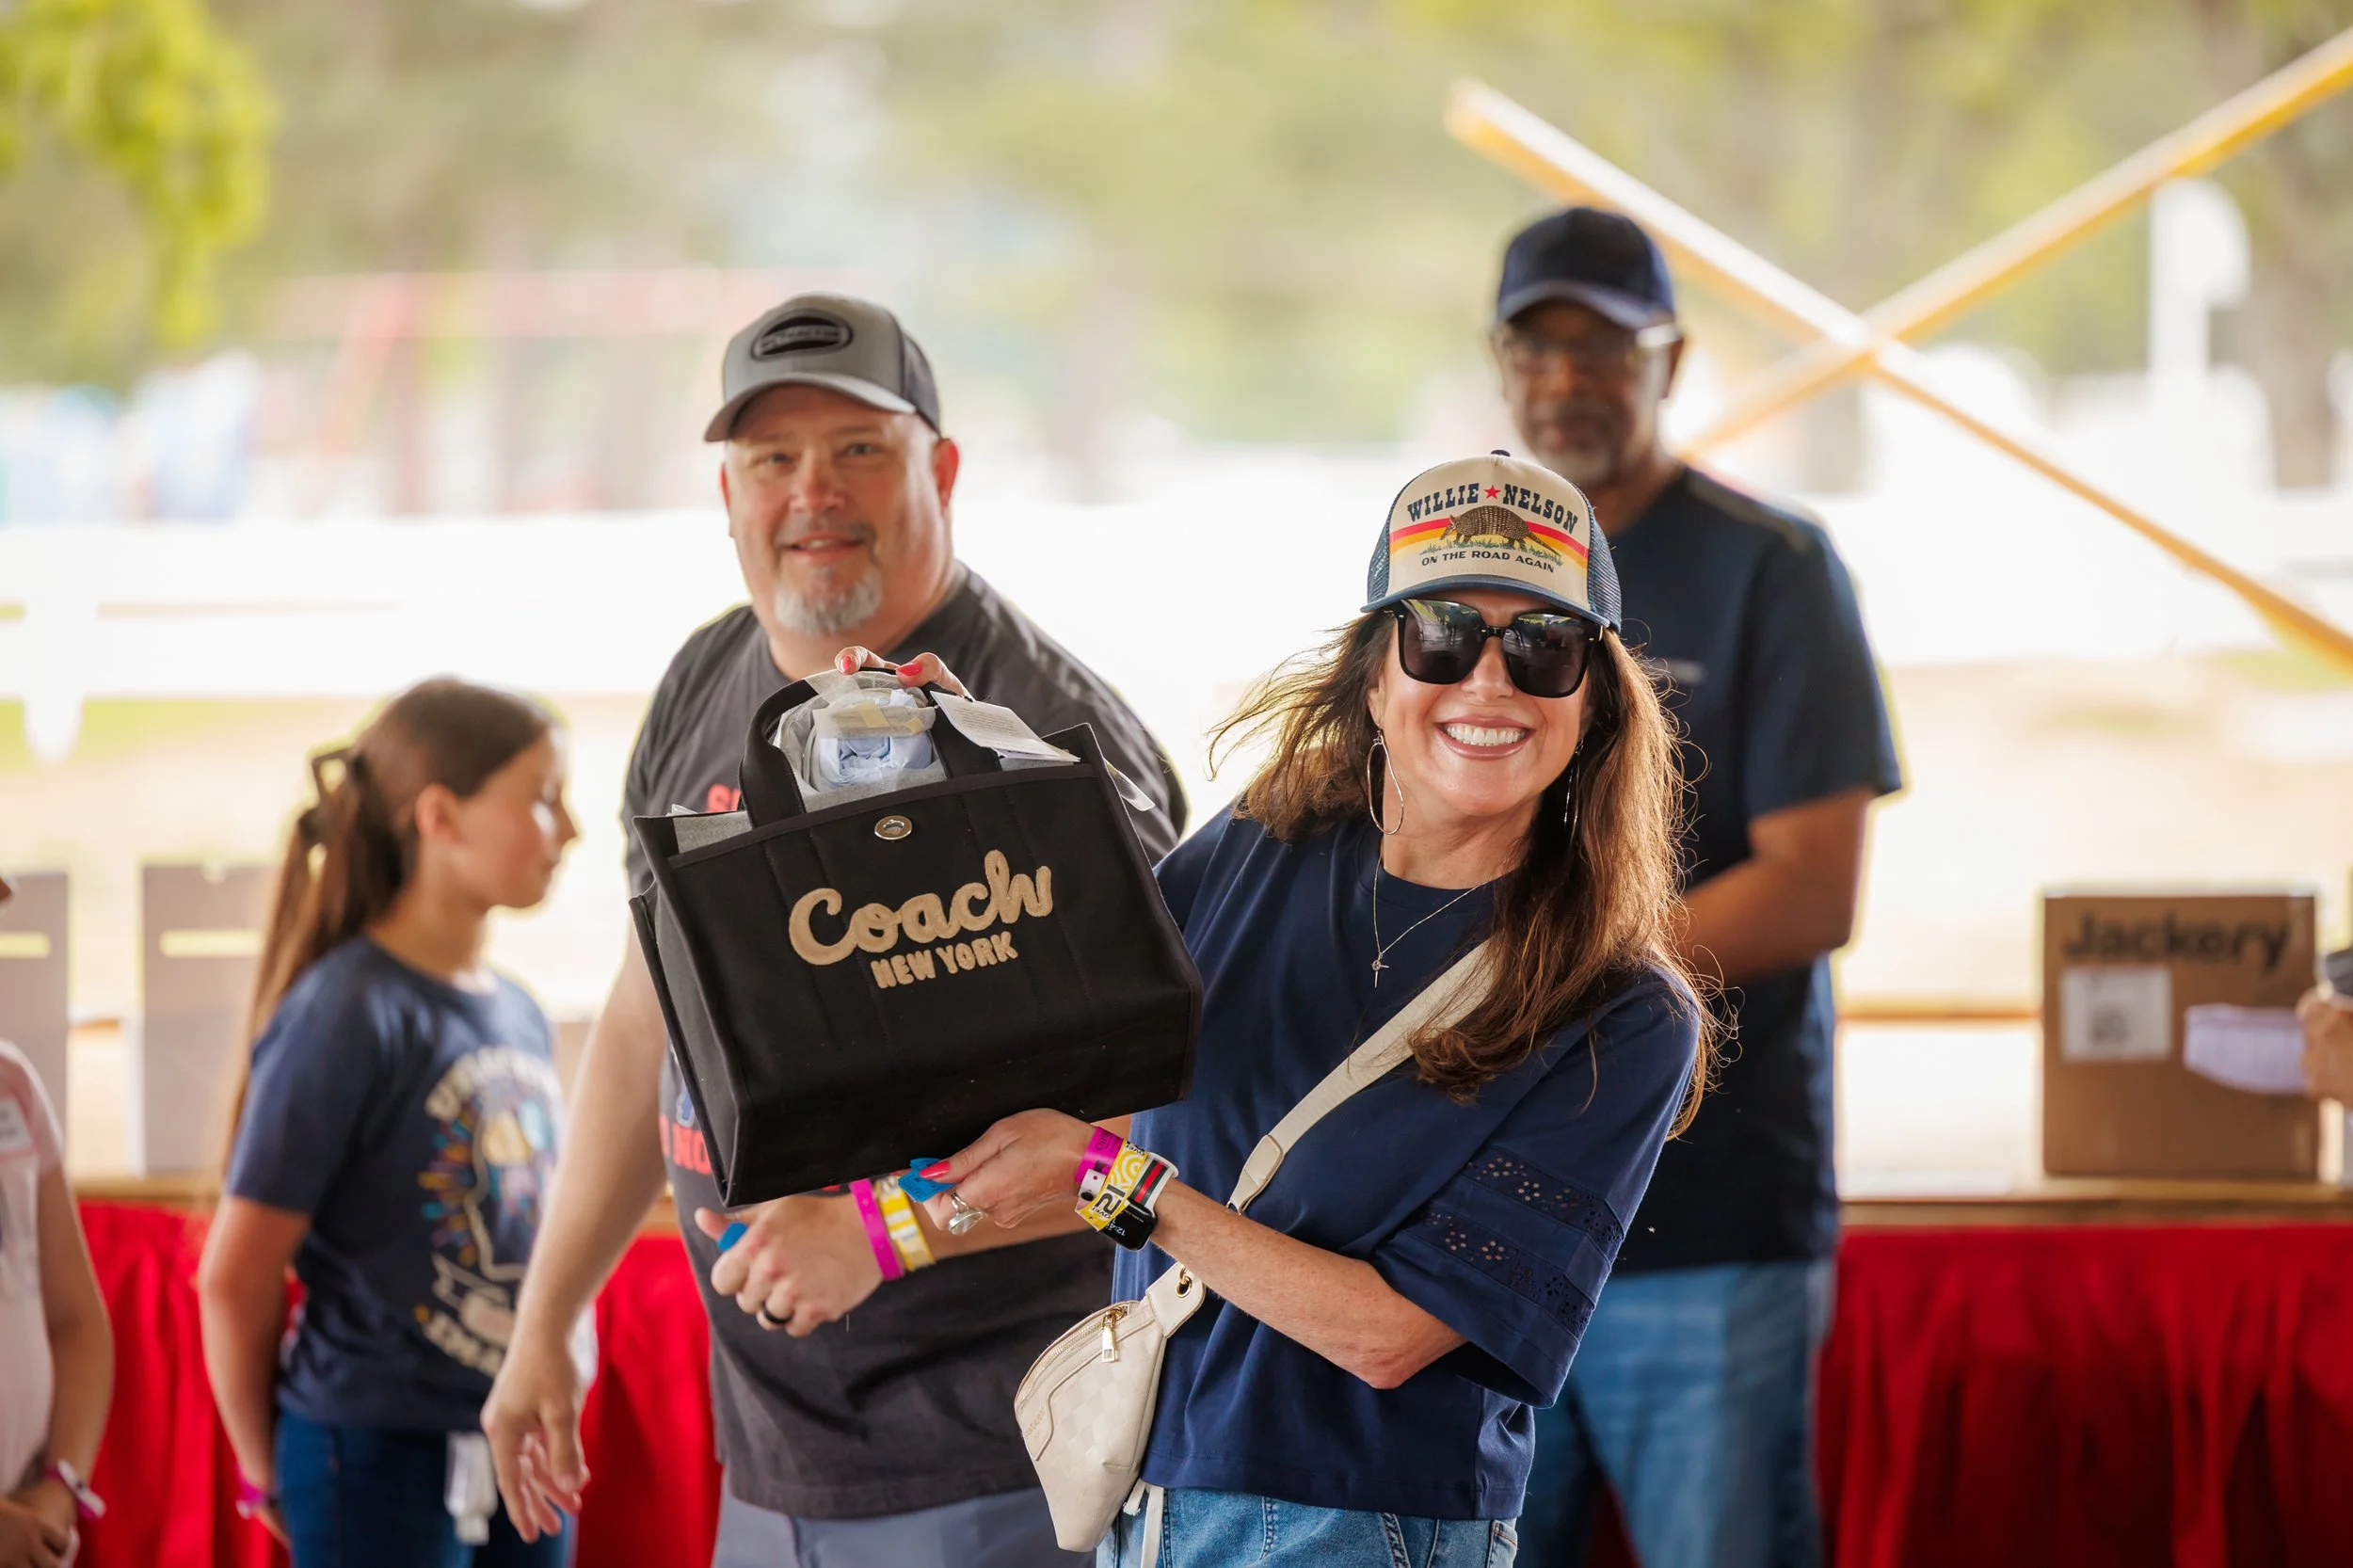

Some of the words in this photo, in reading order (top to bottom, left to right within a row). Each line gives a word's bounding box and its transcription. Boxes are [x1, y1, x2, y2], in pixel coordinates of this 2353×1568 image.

[1407, 483, 1480, 522] WILLIE
[1502, 484, 1578, 535] NELSON
[1421, 554, 1438, 567] ON
[1442, 551, 1466, 561] THE
[1471, 551, 1511, 561] ROAD
[1514, 554, 1555, 573] AGAIN
[789, 850, 1054, 966] Coach
[871, 950, 936, 988] NEW
[936, 931, 1019, 974] YORK
[2063, 910, 2291, 975] Jackery
